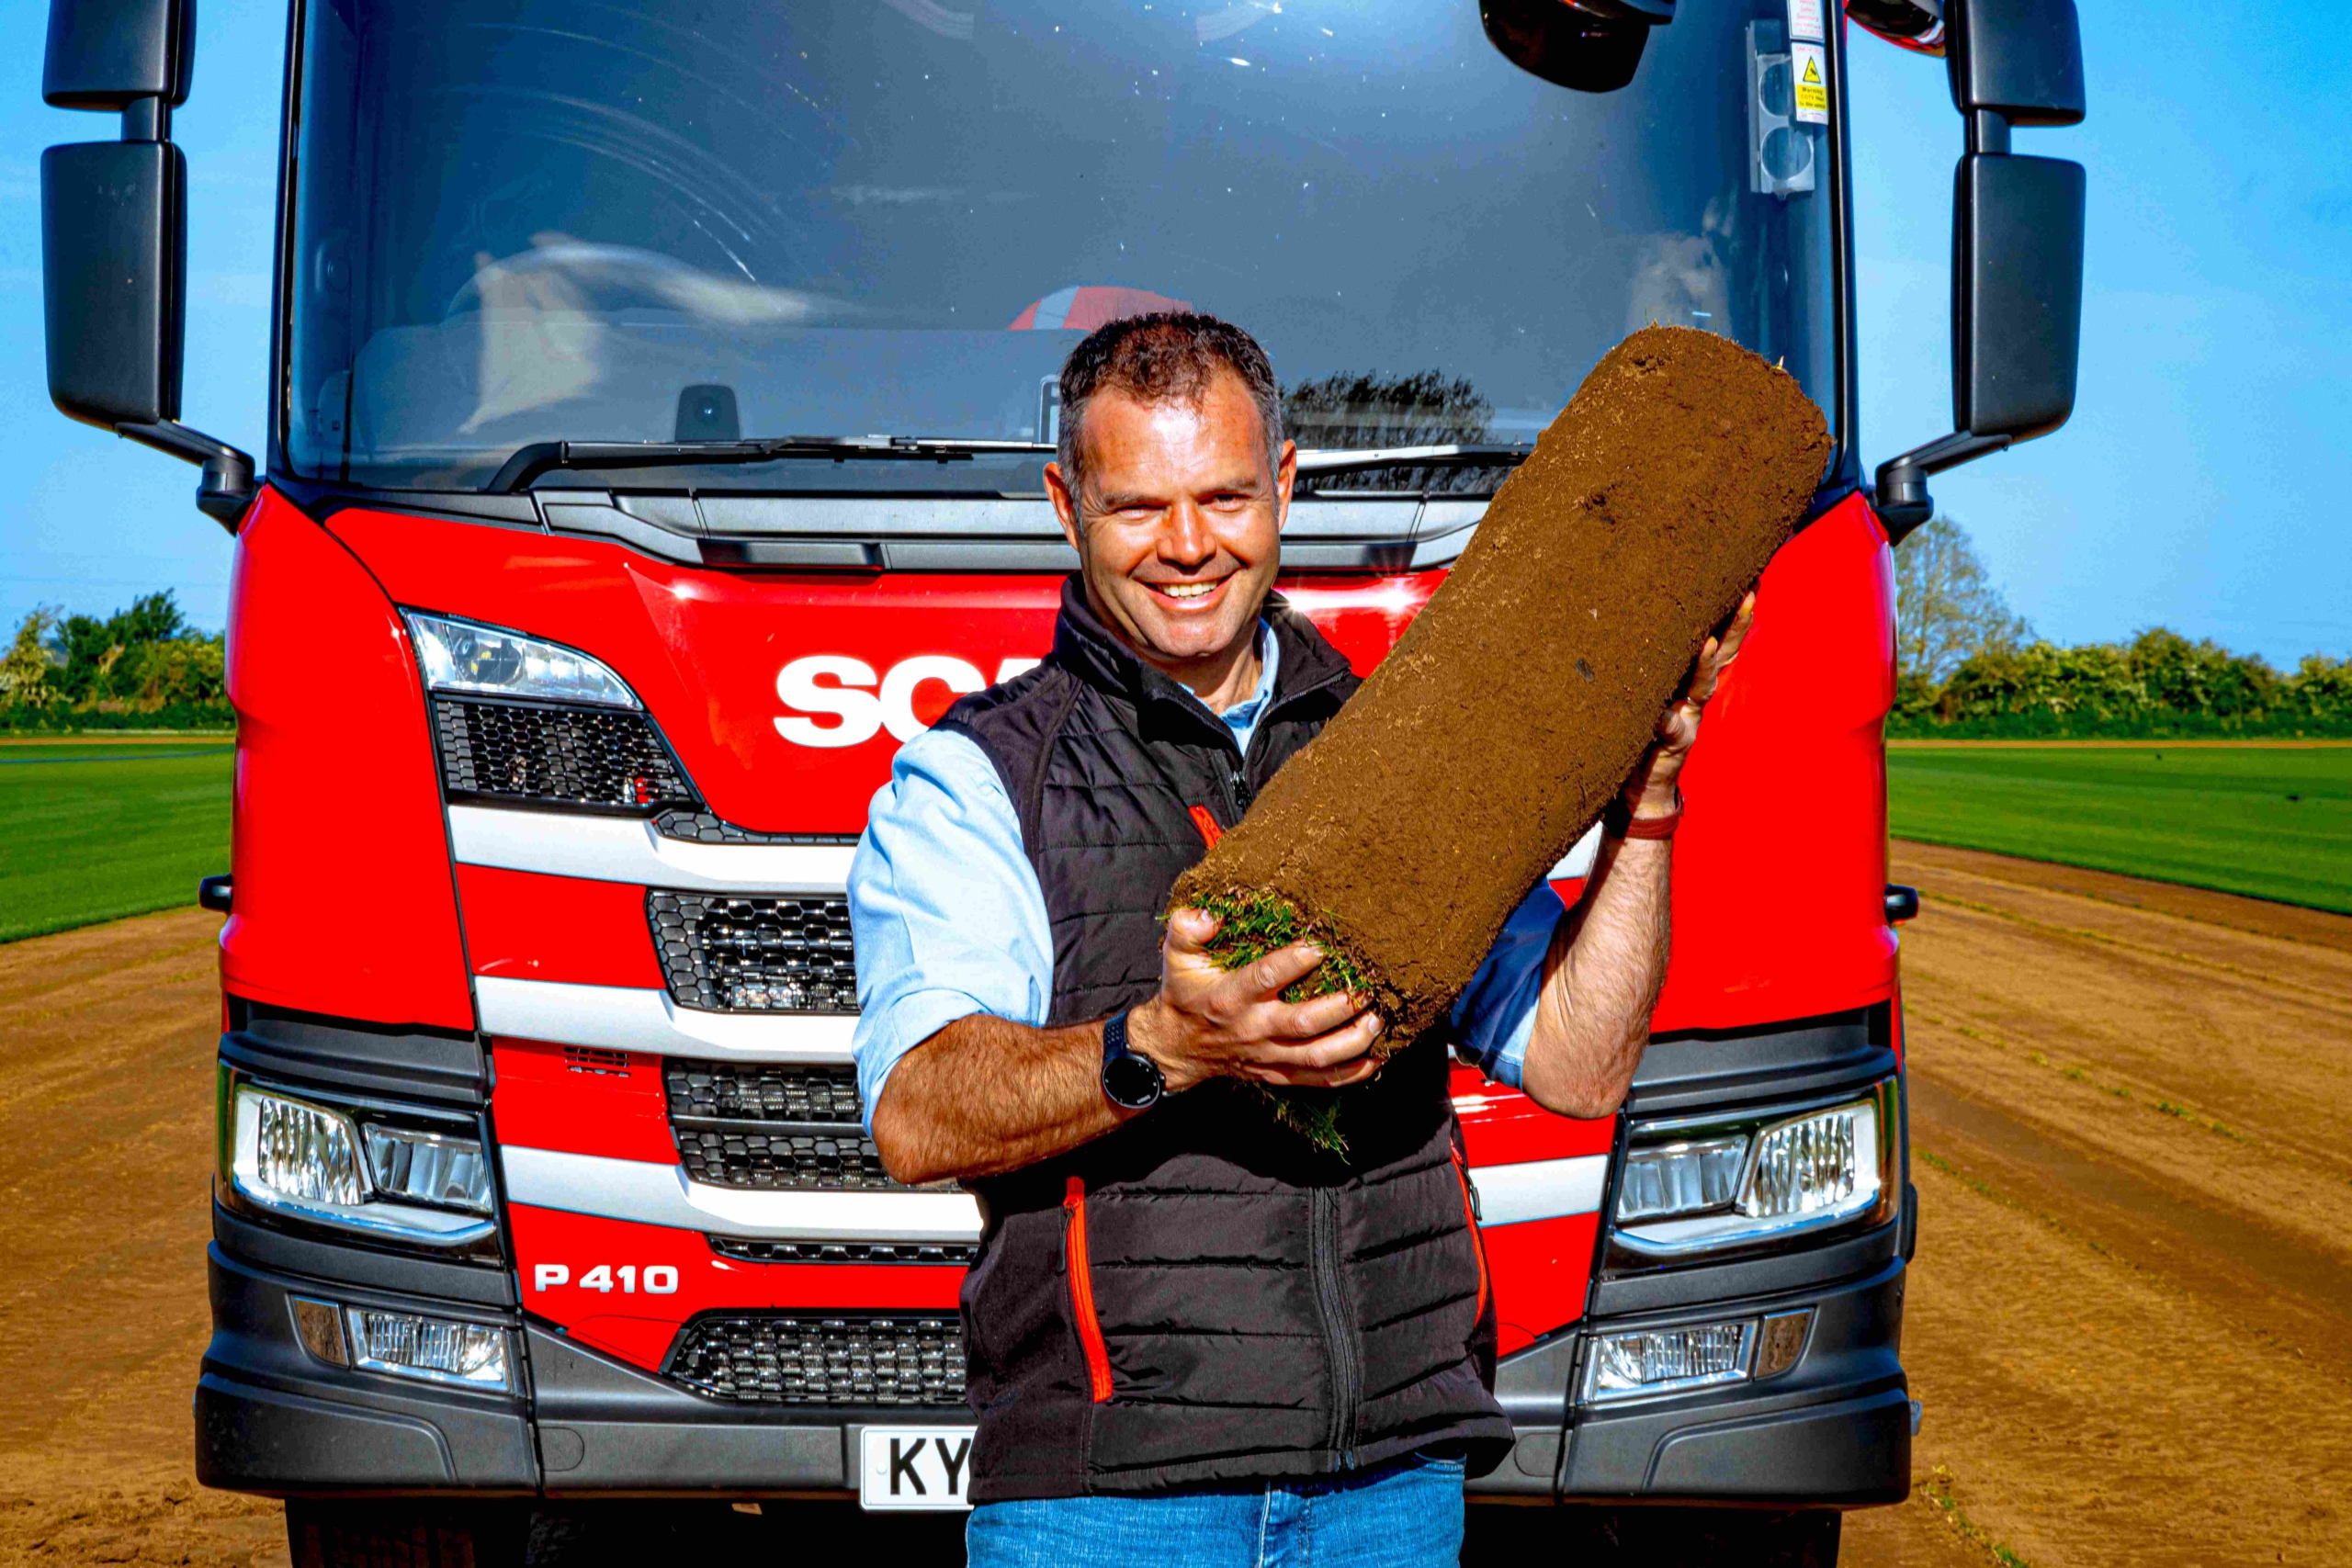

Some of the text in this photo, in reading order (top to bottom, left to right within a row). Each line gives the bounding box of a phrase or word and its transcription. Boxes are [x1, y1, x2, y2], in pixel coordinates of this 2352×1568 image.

[1802, 86, 1823, 96] Warning
[774, 655, 1043, 748] SC
[535, 1264, 678, 1294] P 410
